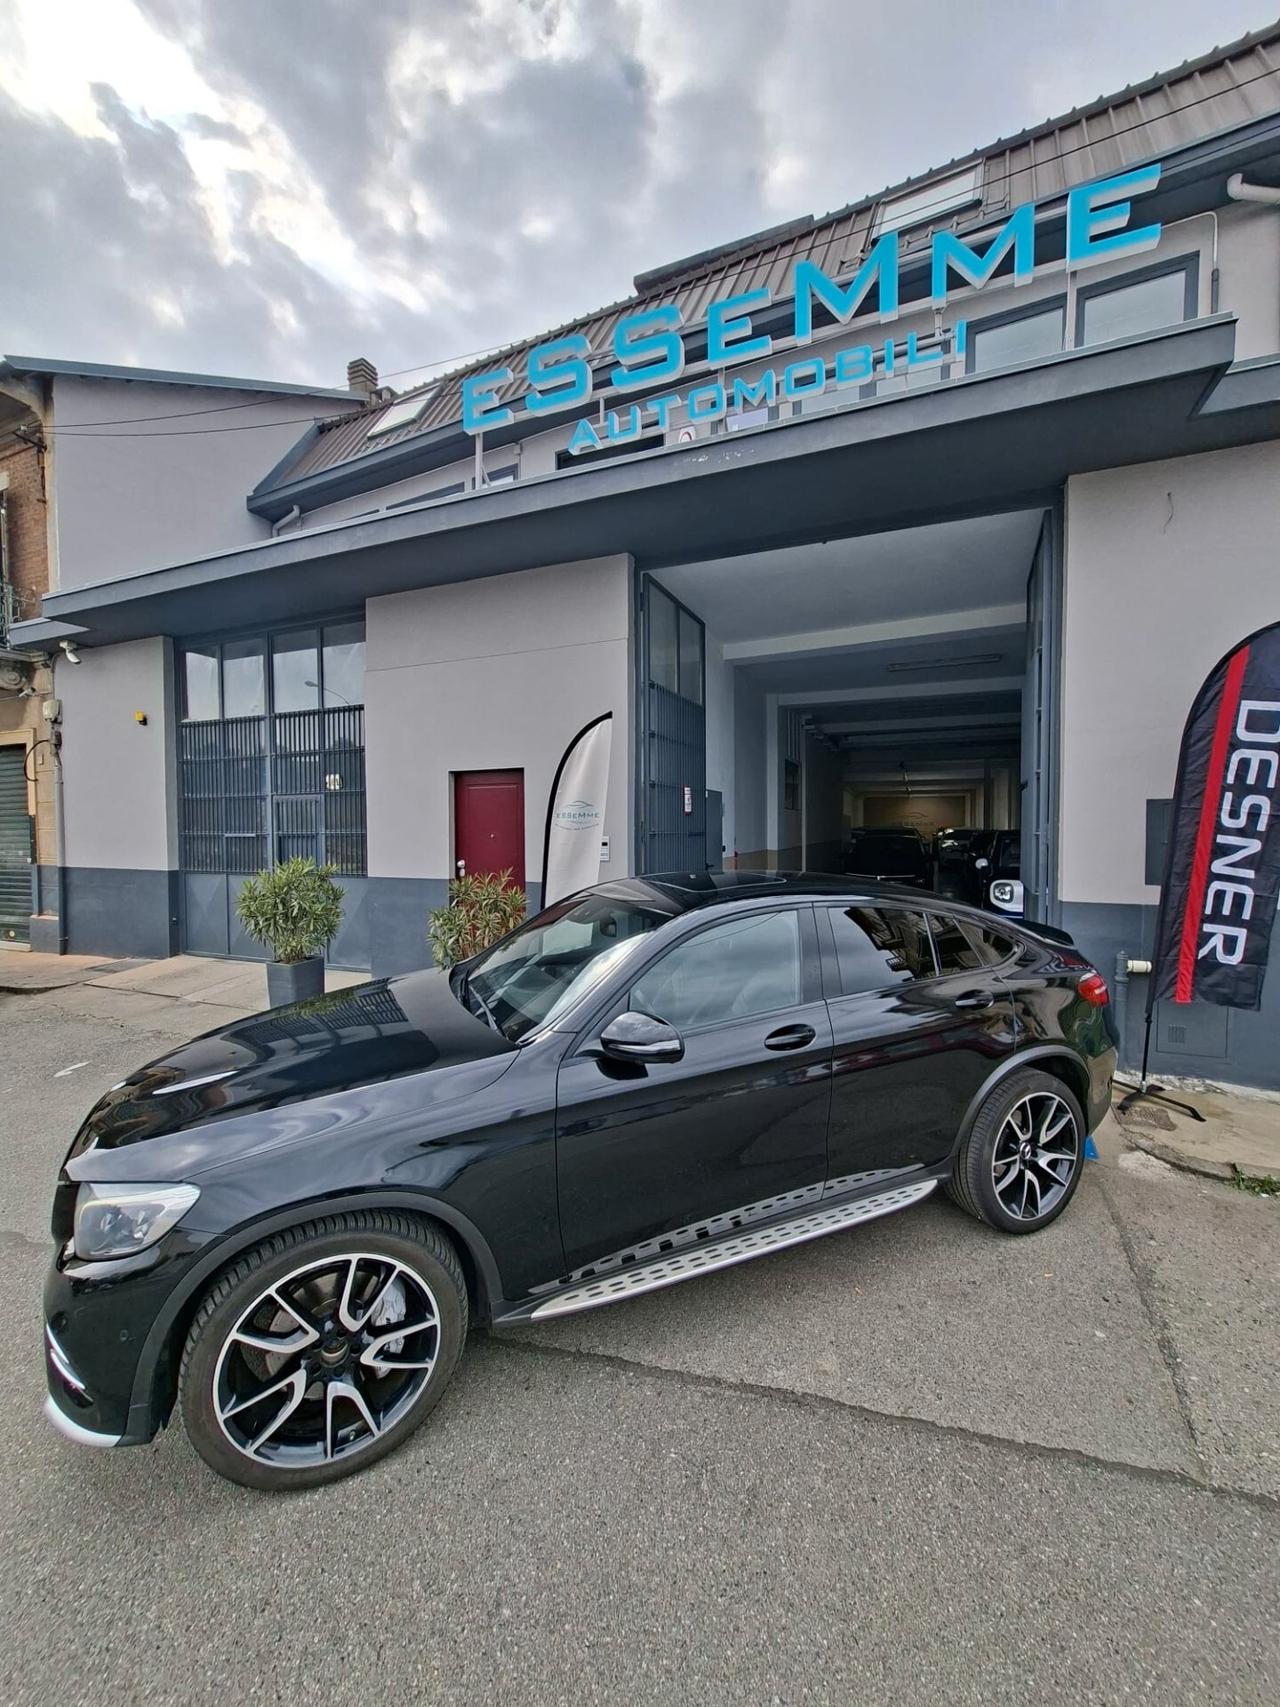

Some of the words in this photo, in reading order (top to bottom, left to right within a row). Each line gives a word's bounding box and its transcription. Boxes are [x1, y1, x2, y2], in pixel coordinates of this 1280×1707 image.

[462, 163, 1163, 435] ESSEMME
[567, 319, 968, 456] AUTOMOBILI
[1198, 699, 1280, 965] DESNER
